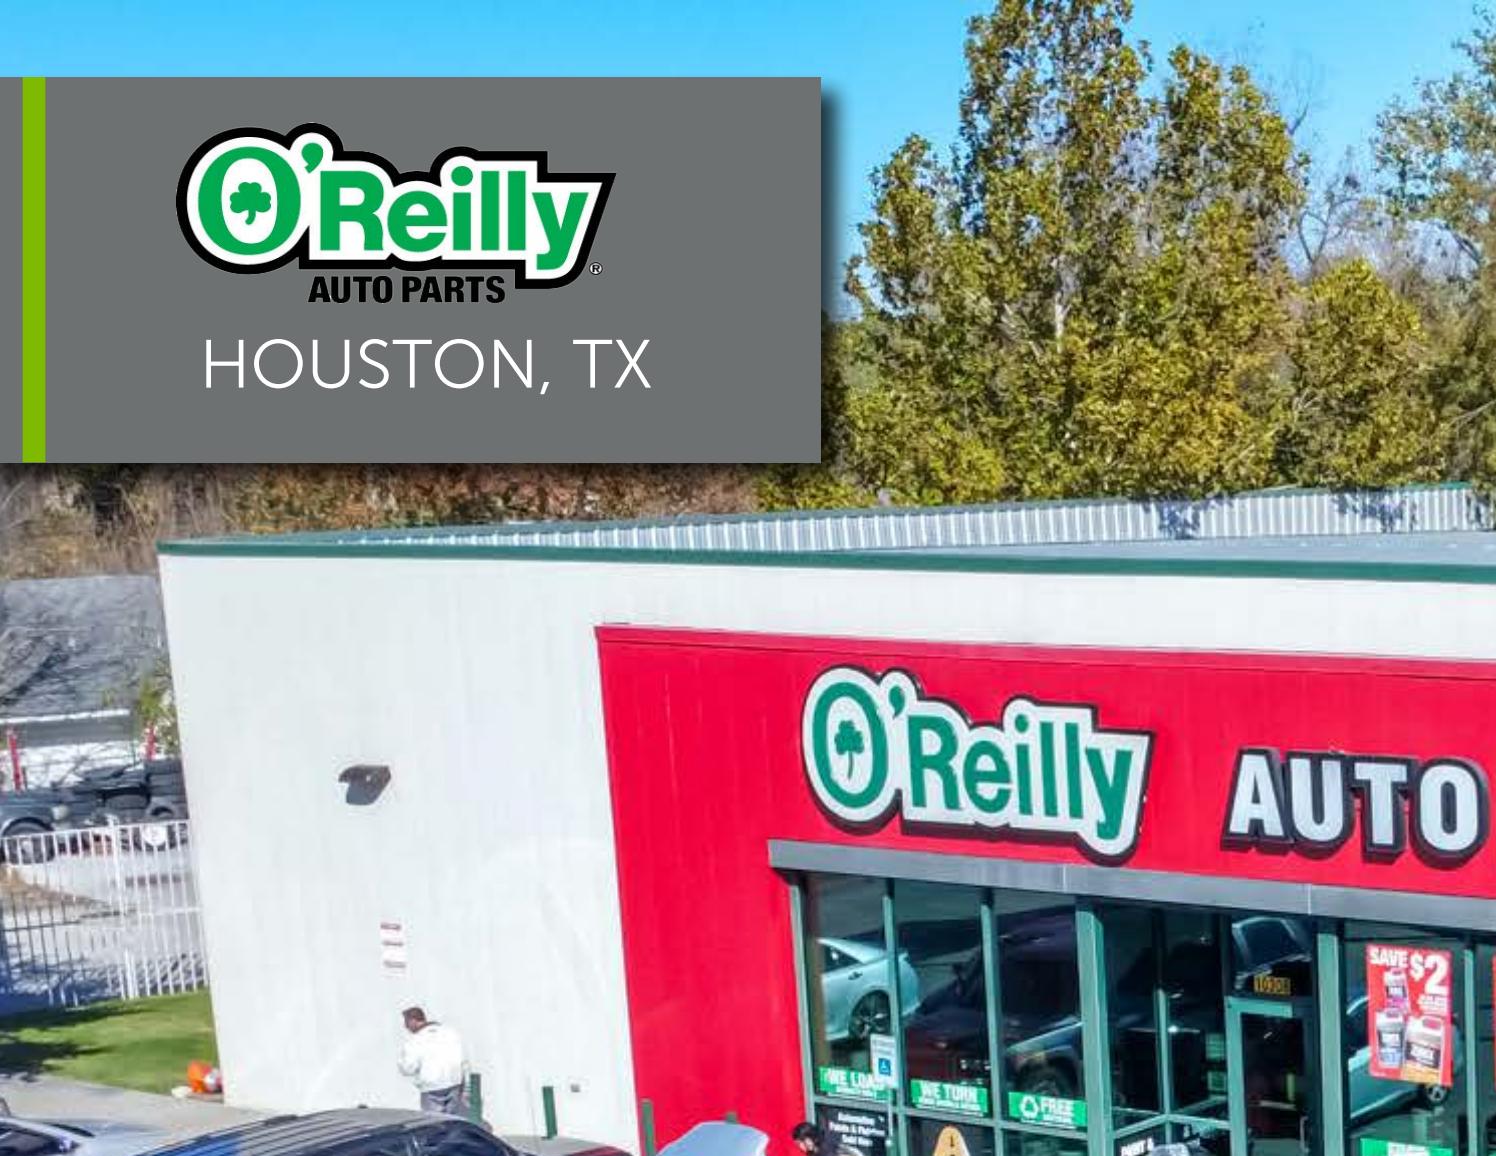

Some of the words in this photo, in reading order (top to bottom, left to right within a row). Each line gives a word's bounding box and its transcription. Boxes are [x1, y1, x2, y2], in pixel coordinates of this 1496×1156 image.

[812, 681, 1133, 840] O'Reilly
[1227, 752, 1481, 854] AUTO
[1369, 947, 1408, 969] SAVE
[1410, 951, 1449, 996] $2
[922, 1080, 941, 1098] WE
[1040, 1096, 1074, 1117] FREE
